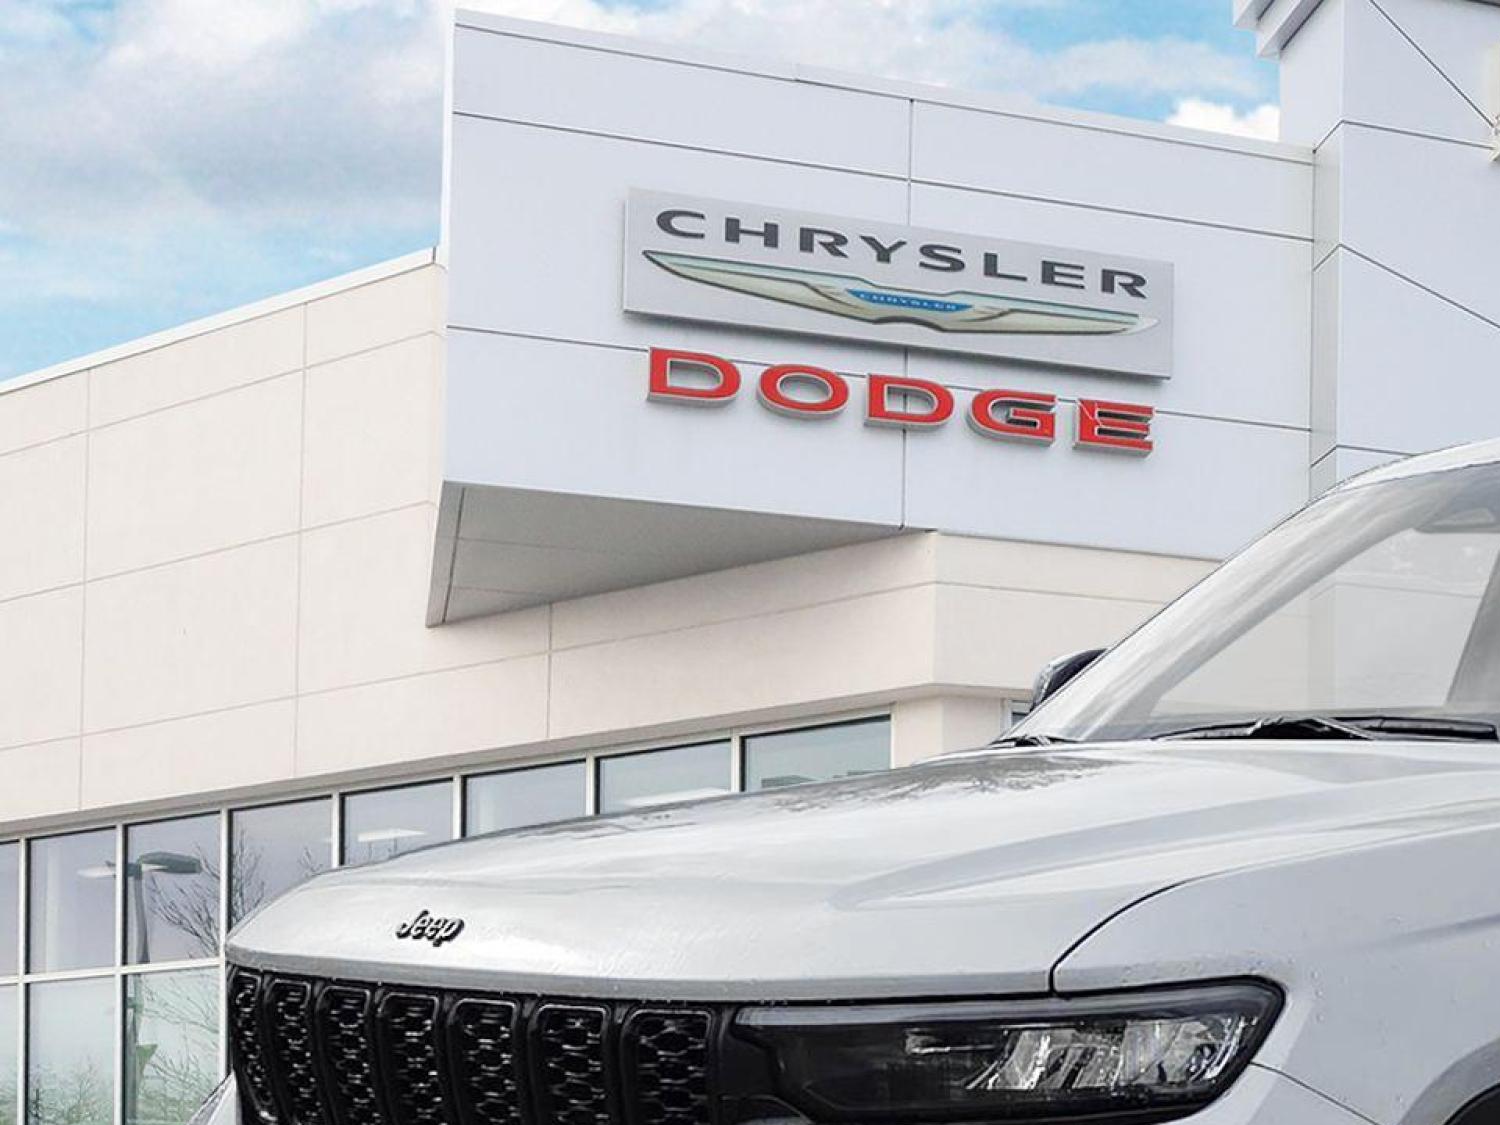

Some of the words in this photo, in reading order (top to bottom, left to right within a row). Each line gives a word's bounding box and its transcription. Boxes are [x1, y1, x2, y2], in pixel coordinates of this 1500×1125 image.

[655, 208, 1148, 299] CHRYSLER
[647, 346, 1154, 457] DODGE
[395, 909, 465, 948] Jeep
